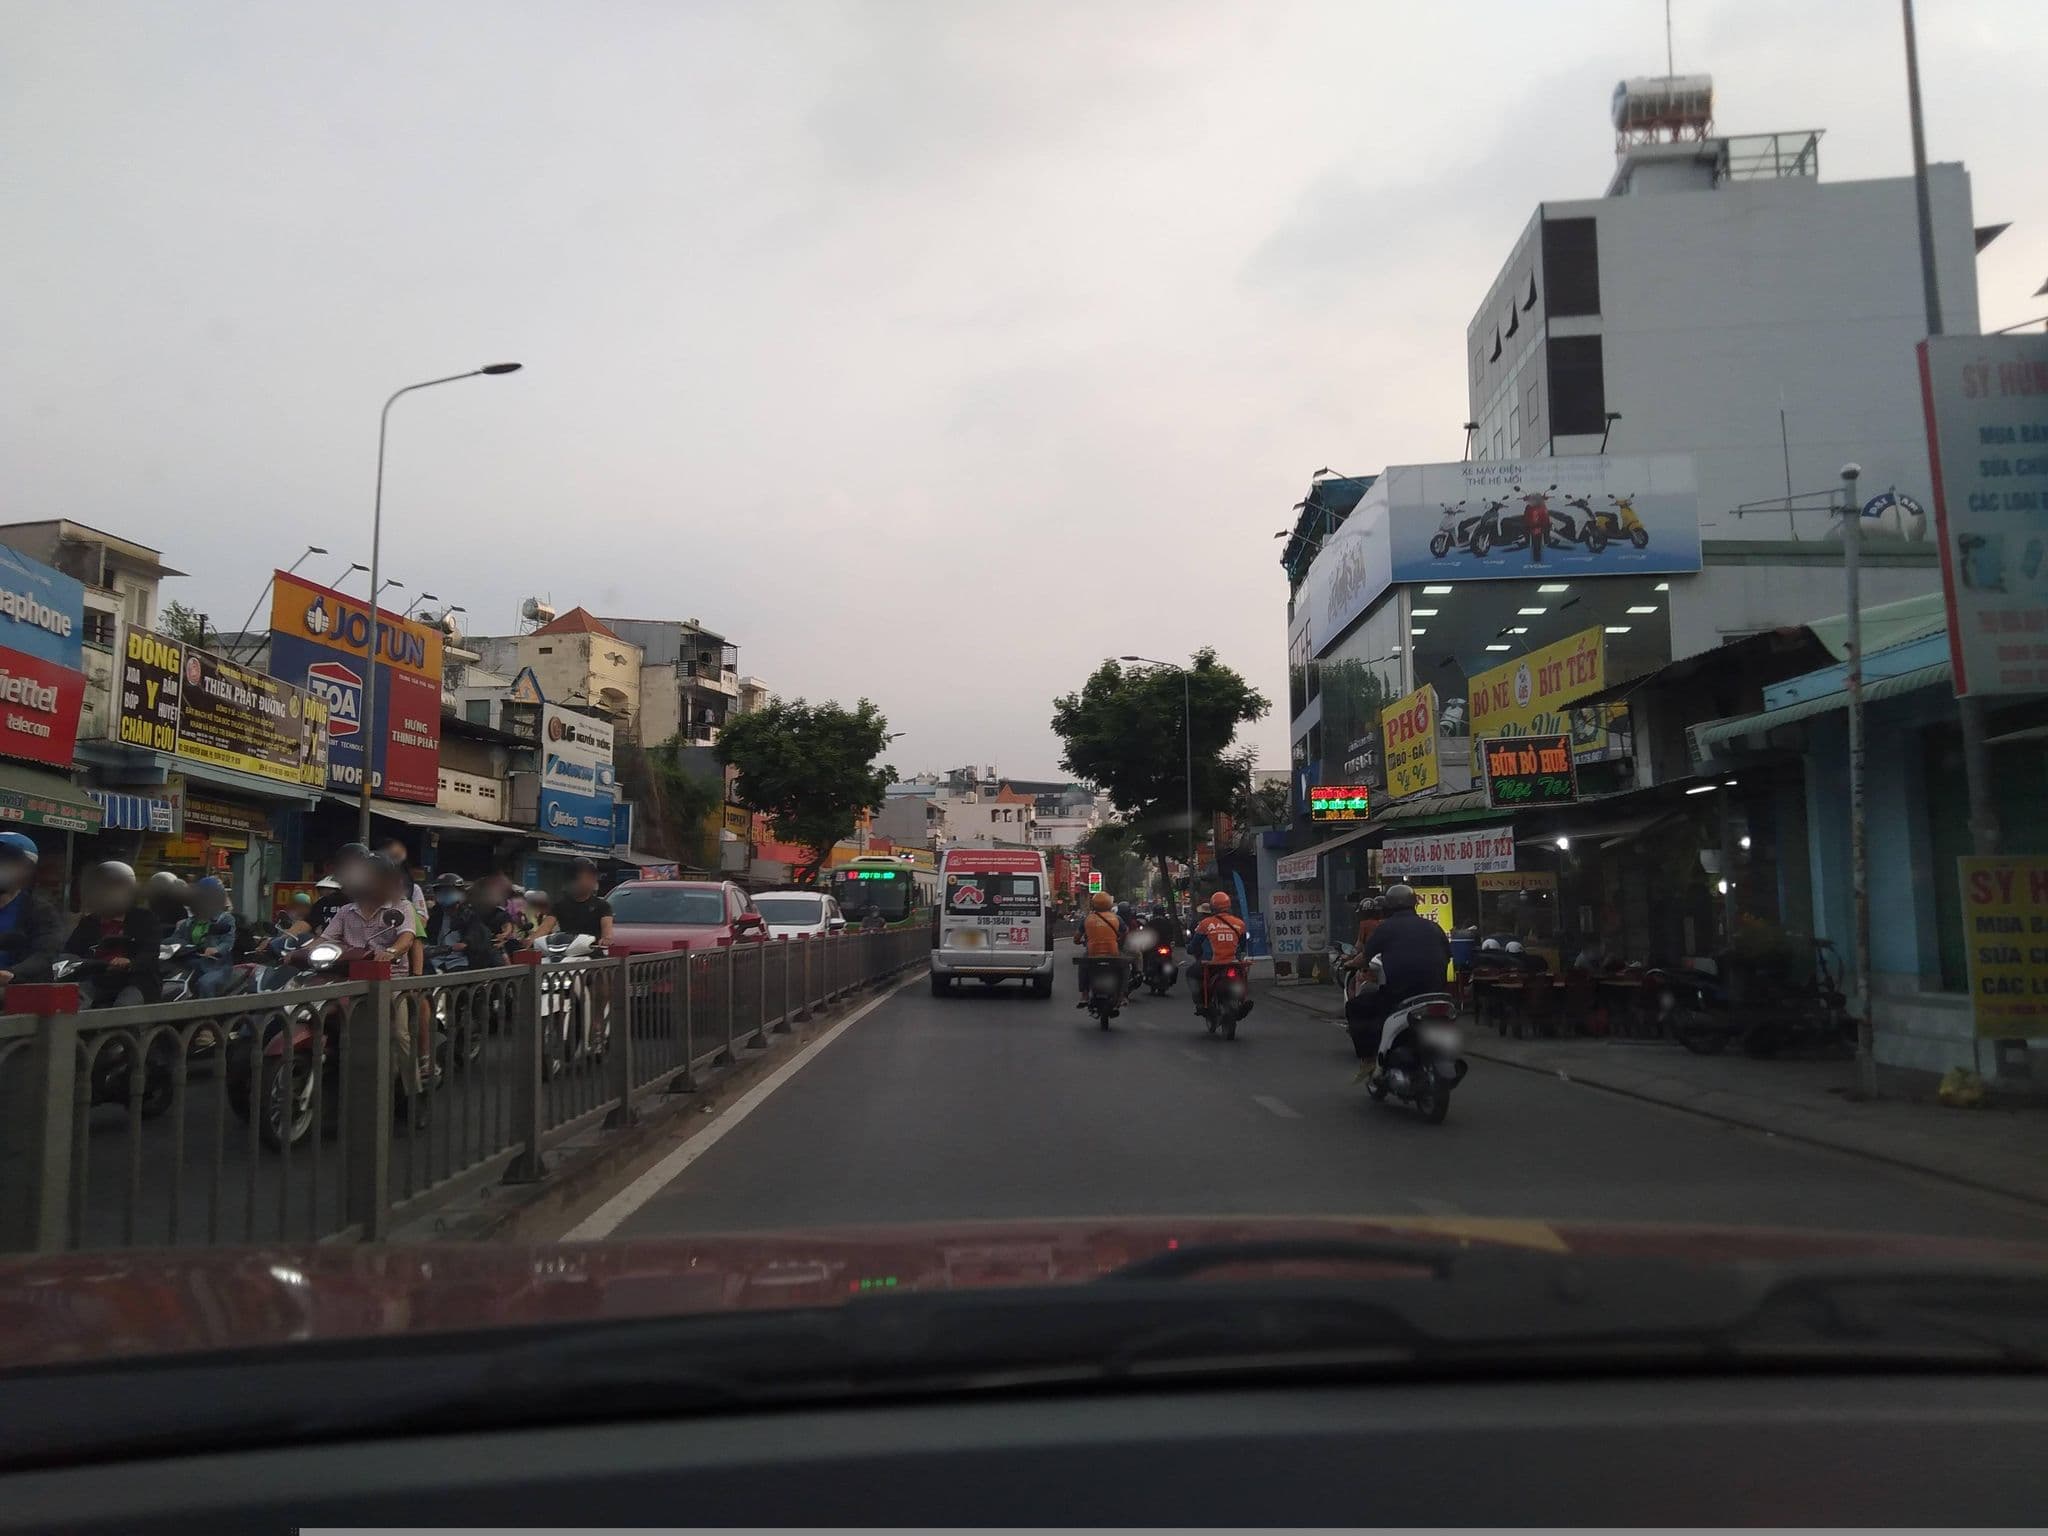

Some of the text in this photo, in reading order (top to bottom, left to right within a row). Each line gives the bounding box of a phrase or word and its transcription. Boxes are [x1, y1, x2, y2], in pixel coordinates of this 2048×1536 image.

[128, 632, 180, 674] ĐÔNG
[1473, 639, 1598, 718] BÒ NÉ BÍT TẾT
[146, 679, 159, 710] Y
[7, 712, 50, 738] telecom
[121, 714, 153, 746] CHÂM
[153, 722, 175, 751] CỨU
[404, 718, 428, 734] HƯNG
[1386, 690, 1430, 748] PHỞ
[391, 730, 439, 751] THỊNH PHÁT
[561, 723, 576, 743] LG
[1490, 738, 1568, 777] BÚN BÒ HUẾ
[332, 764, 382, 788] WORD
[1475, 834, 1491, 859] BÍT
[1494, 830, 1513, 857] TẾT
[1431, 890, 1449, 905] BÒ
[1278, 939, 1303, 953] 35K
